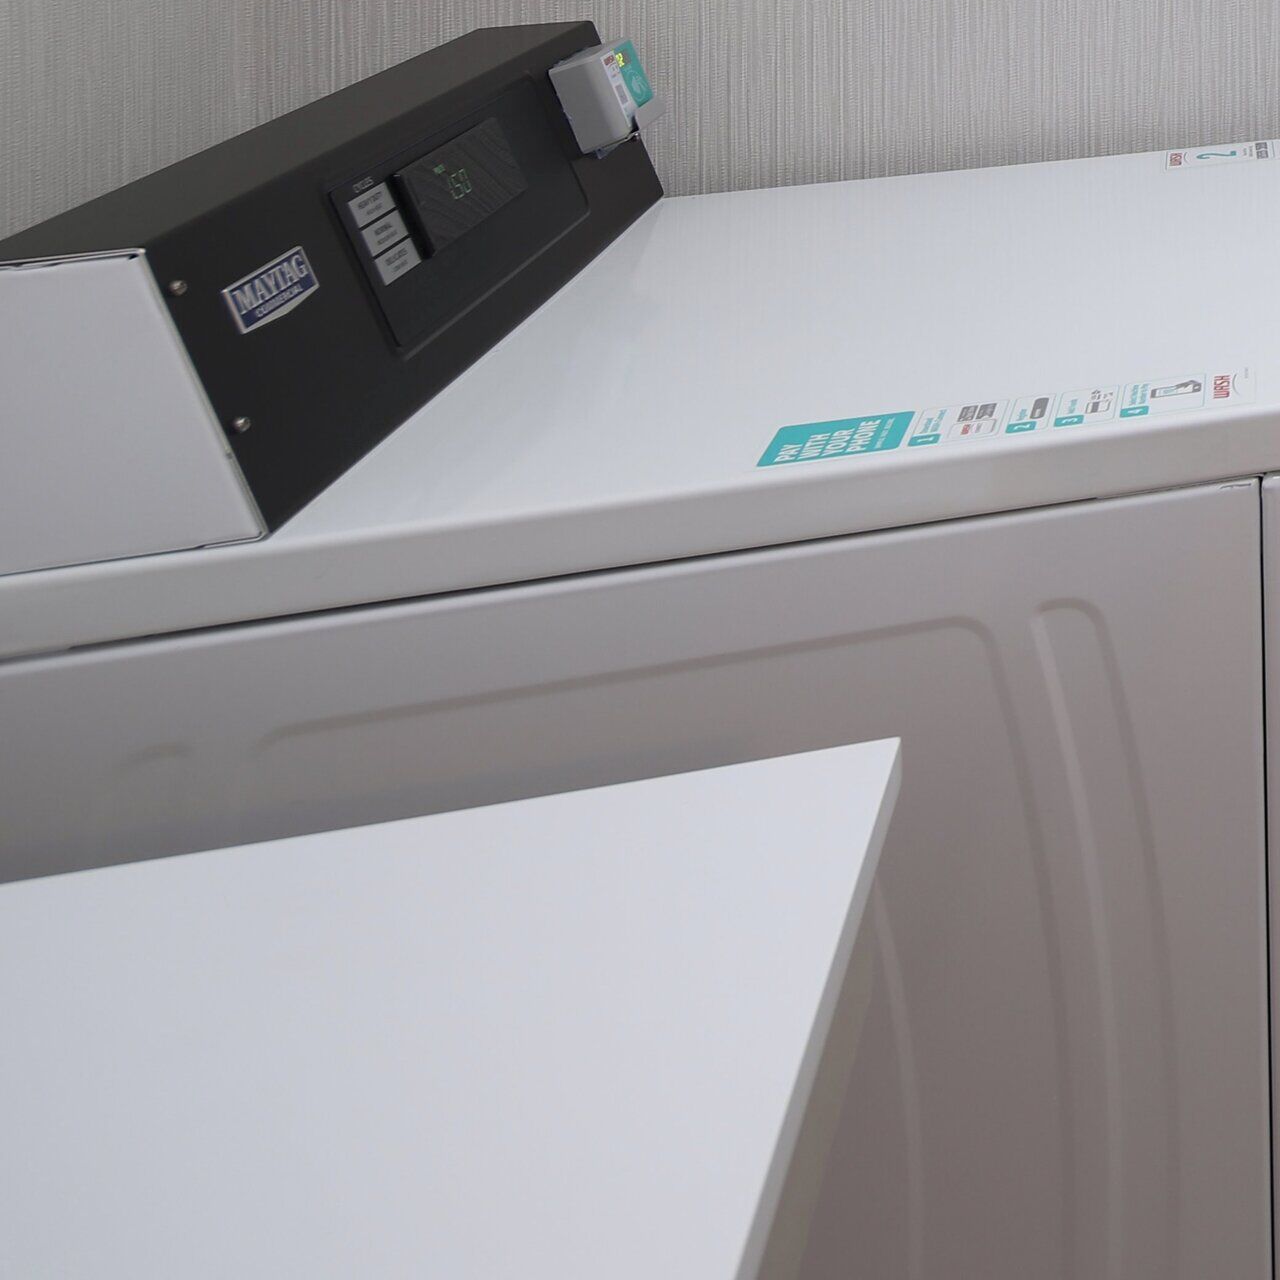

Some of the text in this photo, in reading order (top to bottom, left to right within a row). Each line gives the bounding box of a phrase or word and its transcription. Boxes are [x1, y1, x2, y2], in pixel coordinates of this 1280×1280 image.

[232, 254, 308, 315] MAYTAG
[1213, 374, 1231, 399] WASH
[797, 432, 832, 460] WITH
[820, 427, 856, 457] YOUR
[845, 419, 883, 453] PHONE
[773, 443, 802, 463] PAY
